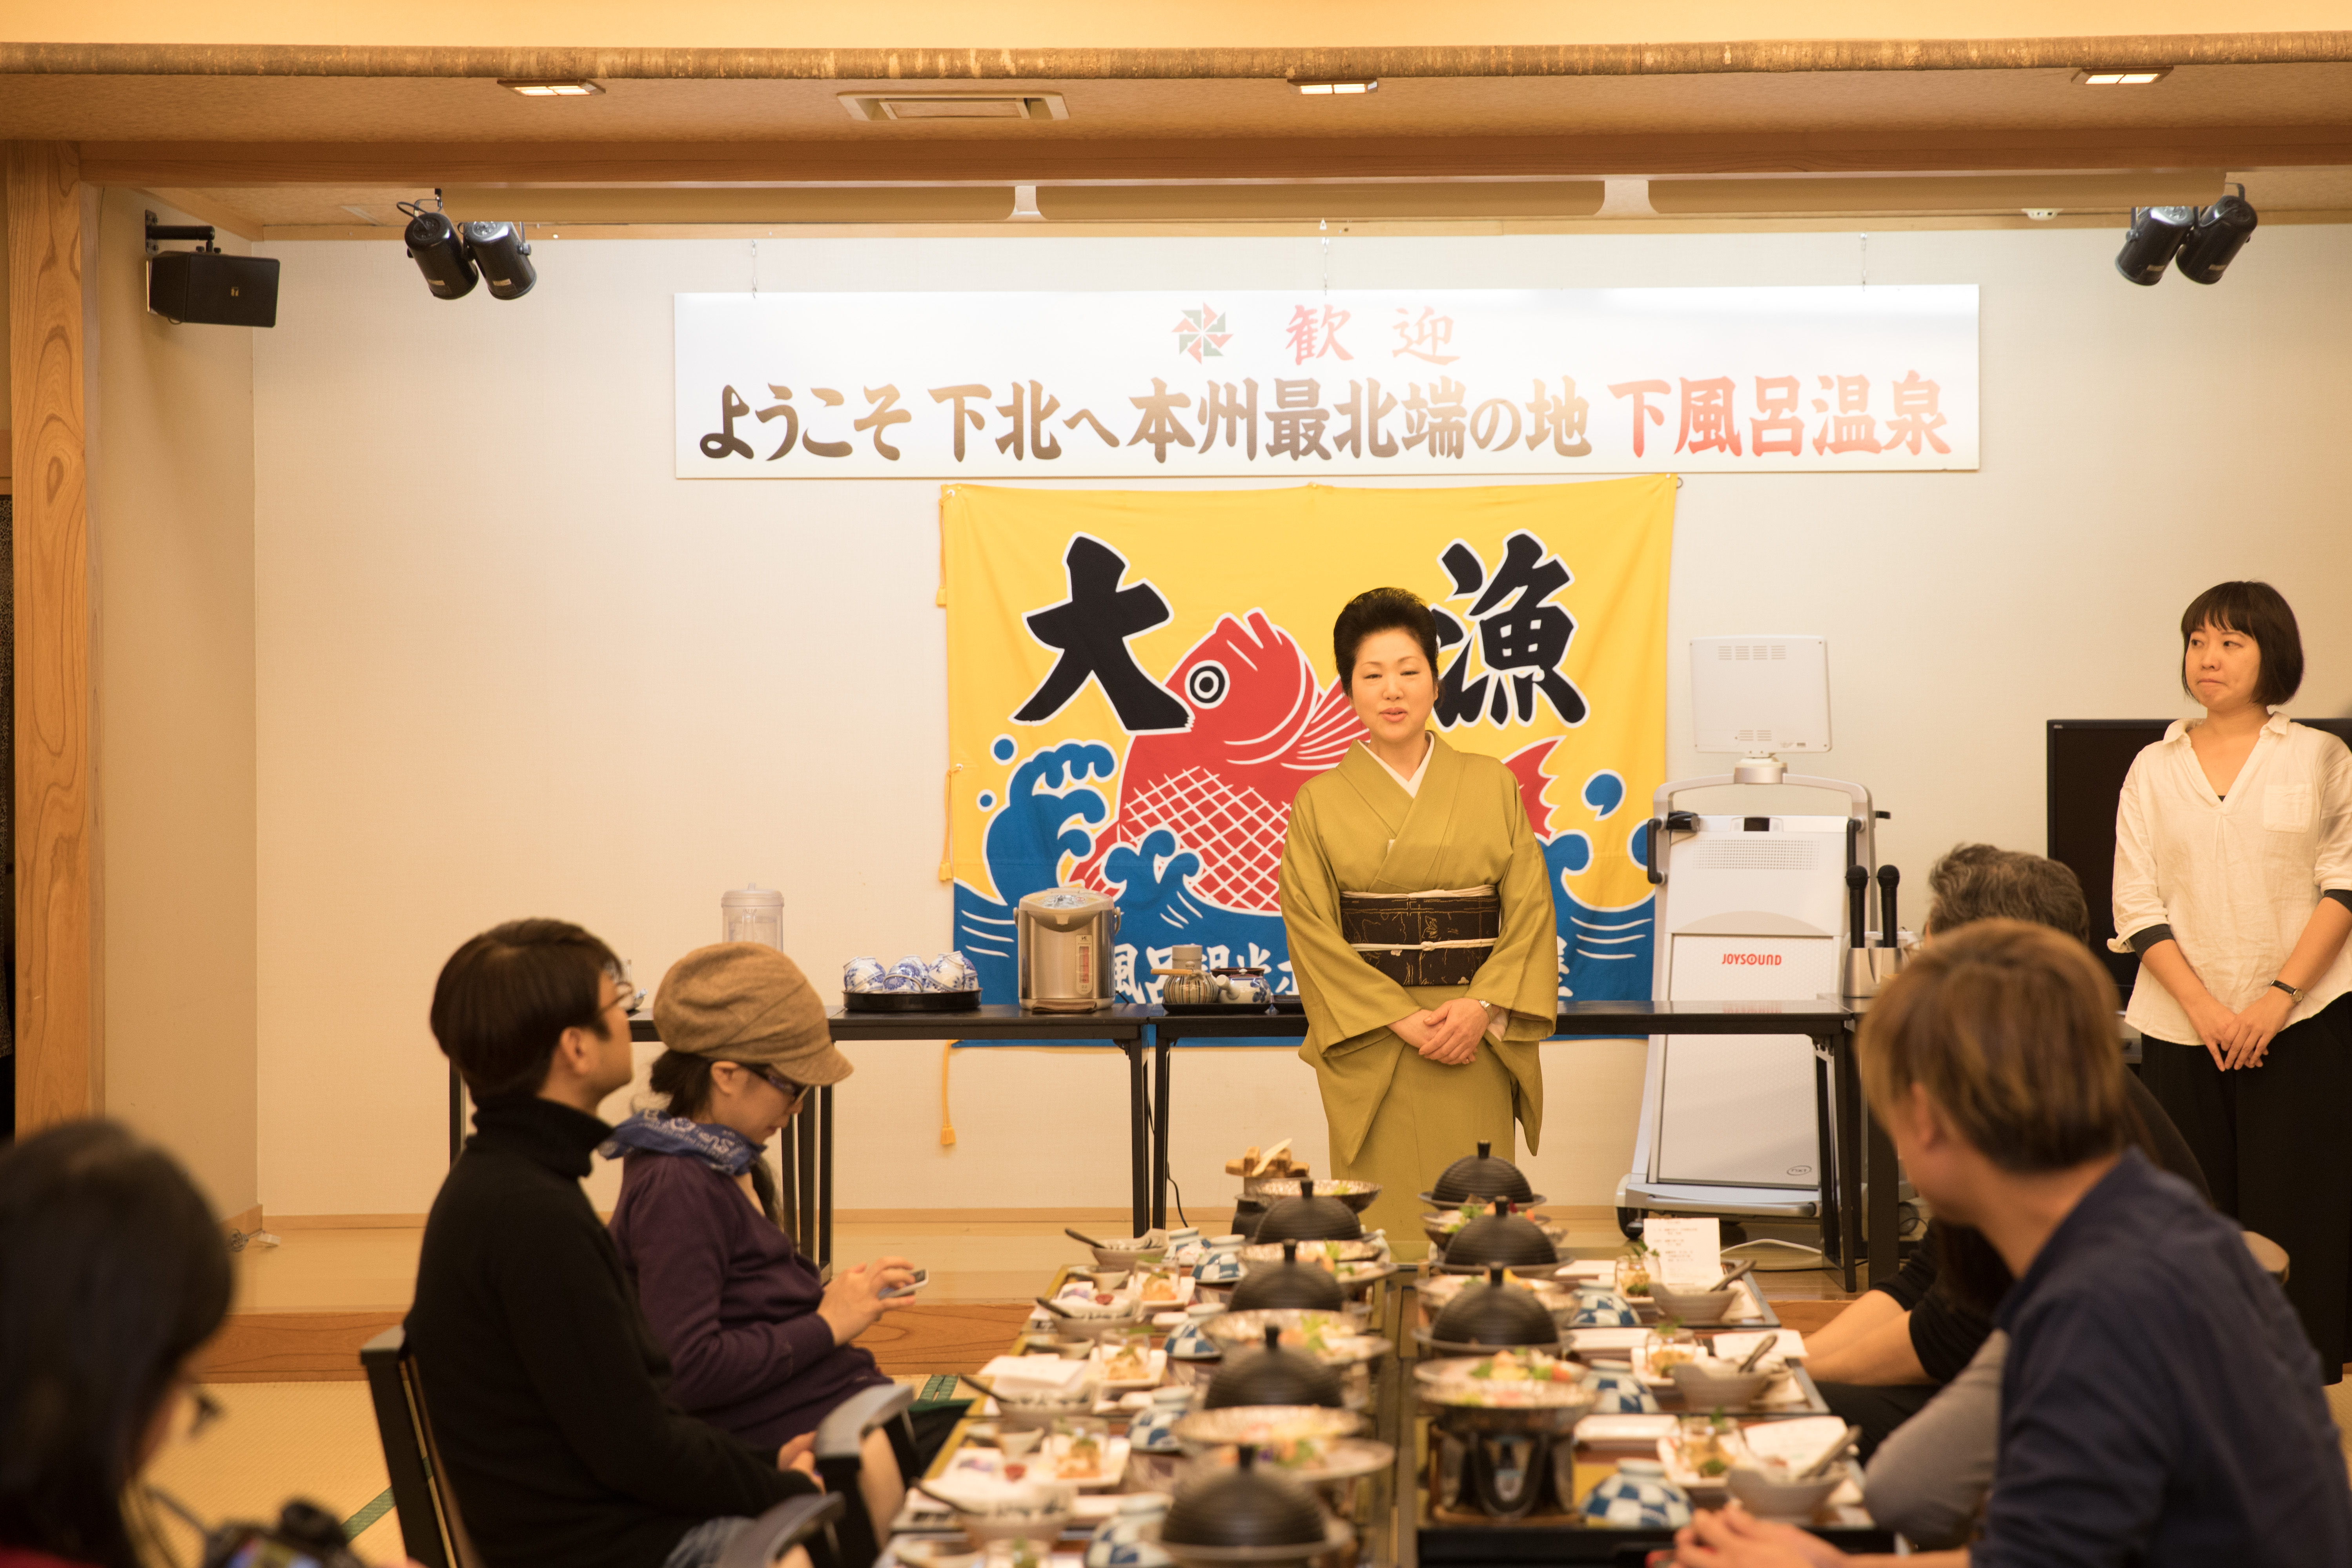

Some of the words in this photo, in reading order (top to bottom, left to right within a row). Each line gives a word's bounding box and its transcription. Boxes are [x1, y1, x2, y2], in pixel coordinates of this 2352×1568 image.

[1285, 304, 1460, 366] 歓迎
[699, 383, 912, 462] ようこそ
[1607, 370, 1952, 458] 下風呂温泉
[1722, 954, 1782, 965] JOYSOUND
